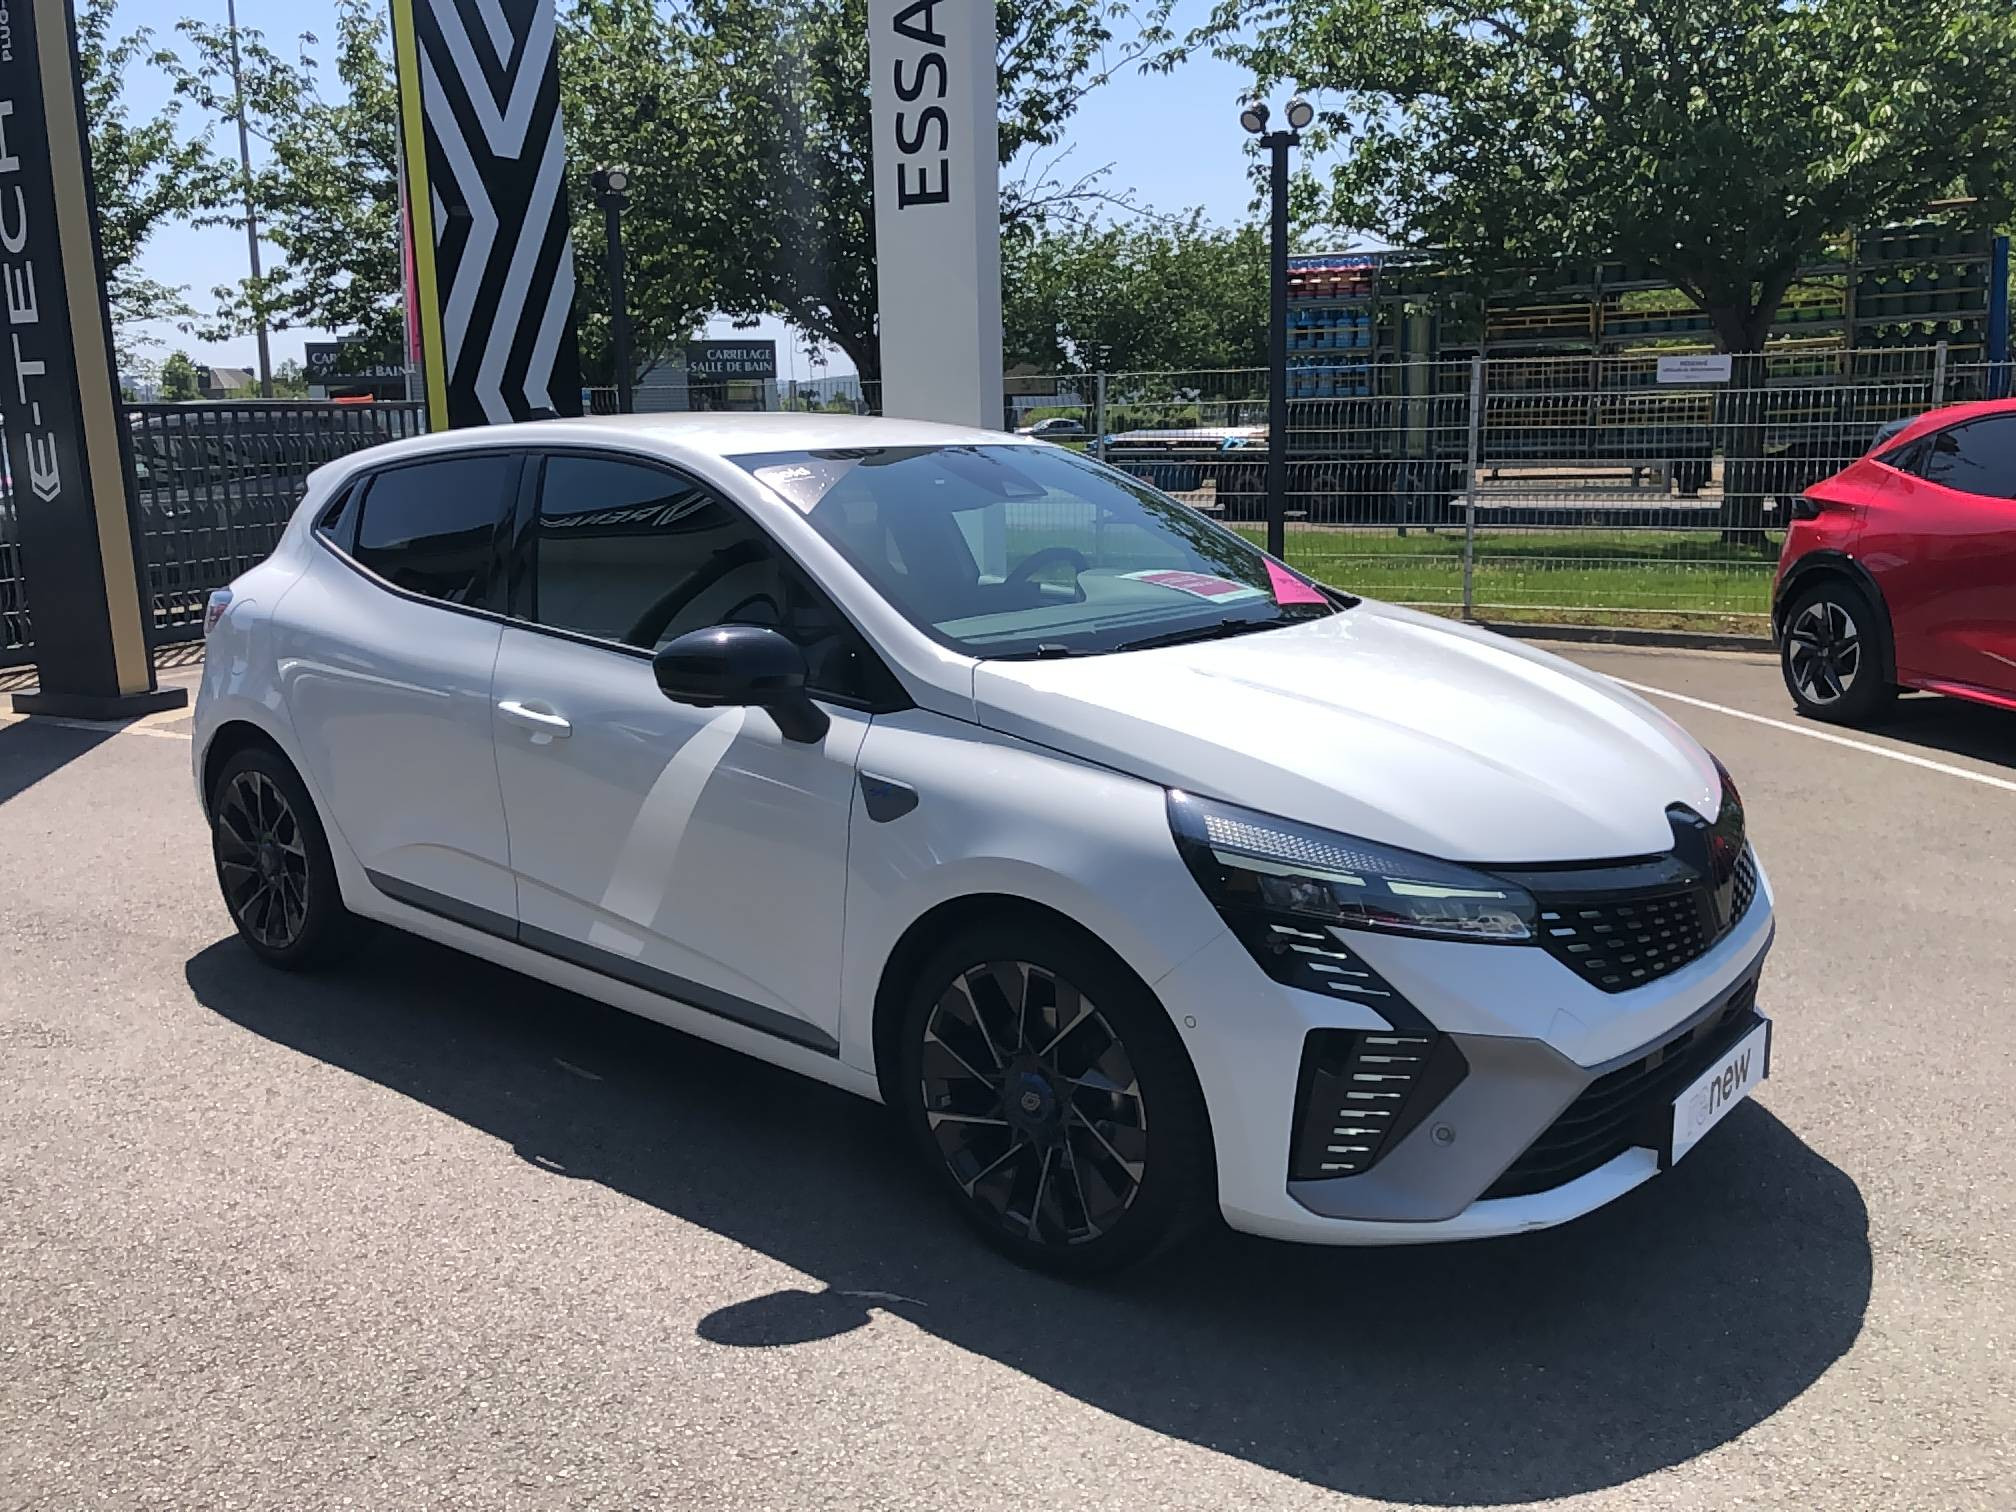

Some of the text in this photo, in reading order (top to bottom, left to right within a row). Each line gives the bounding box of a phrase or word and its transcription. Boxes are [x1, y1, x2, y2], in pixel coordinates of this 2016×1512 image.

[893, 0, 949, 210] ESSA
[706, 349, 772, 360] CARRELAGE
[690, 361, 773, 373] SALLE DE BAIN
